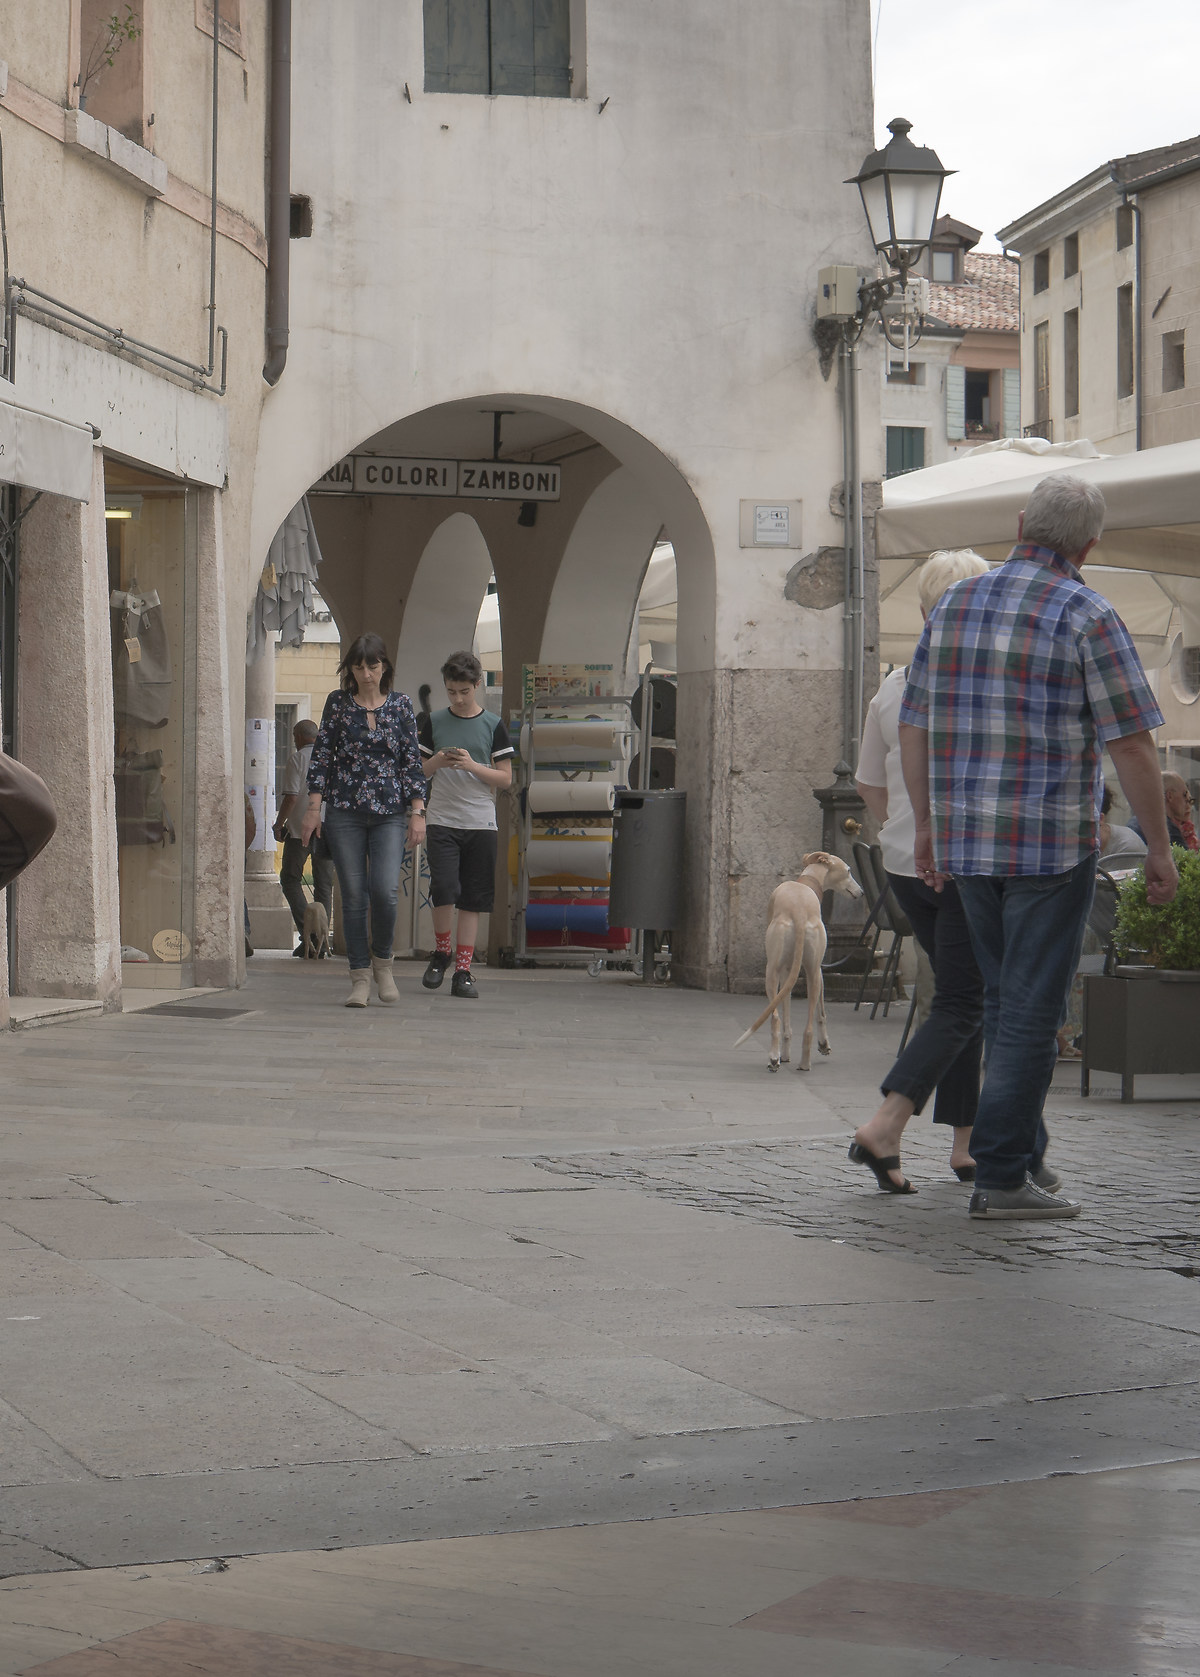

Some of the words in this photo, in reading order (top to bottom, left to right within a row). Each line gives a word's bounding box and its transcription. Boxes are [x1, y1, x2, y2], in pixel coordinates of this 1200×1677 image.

[319, 463, 352, 482] RIA
[365, 464, 447, 486] COLORI
[463, 469, 557, 492] ZAMBONI
